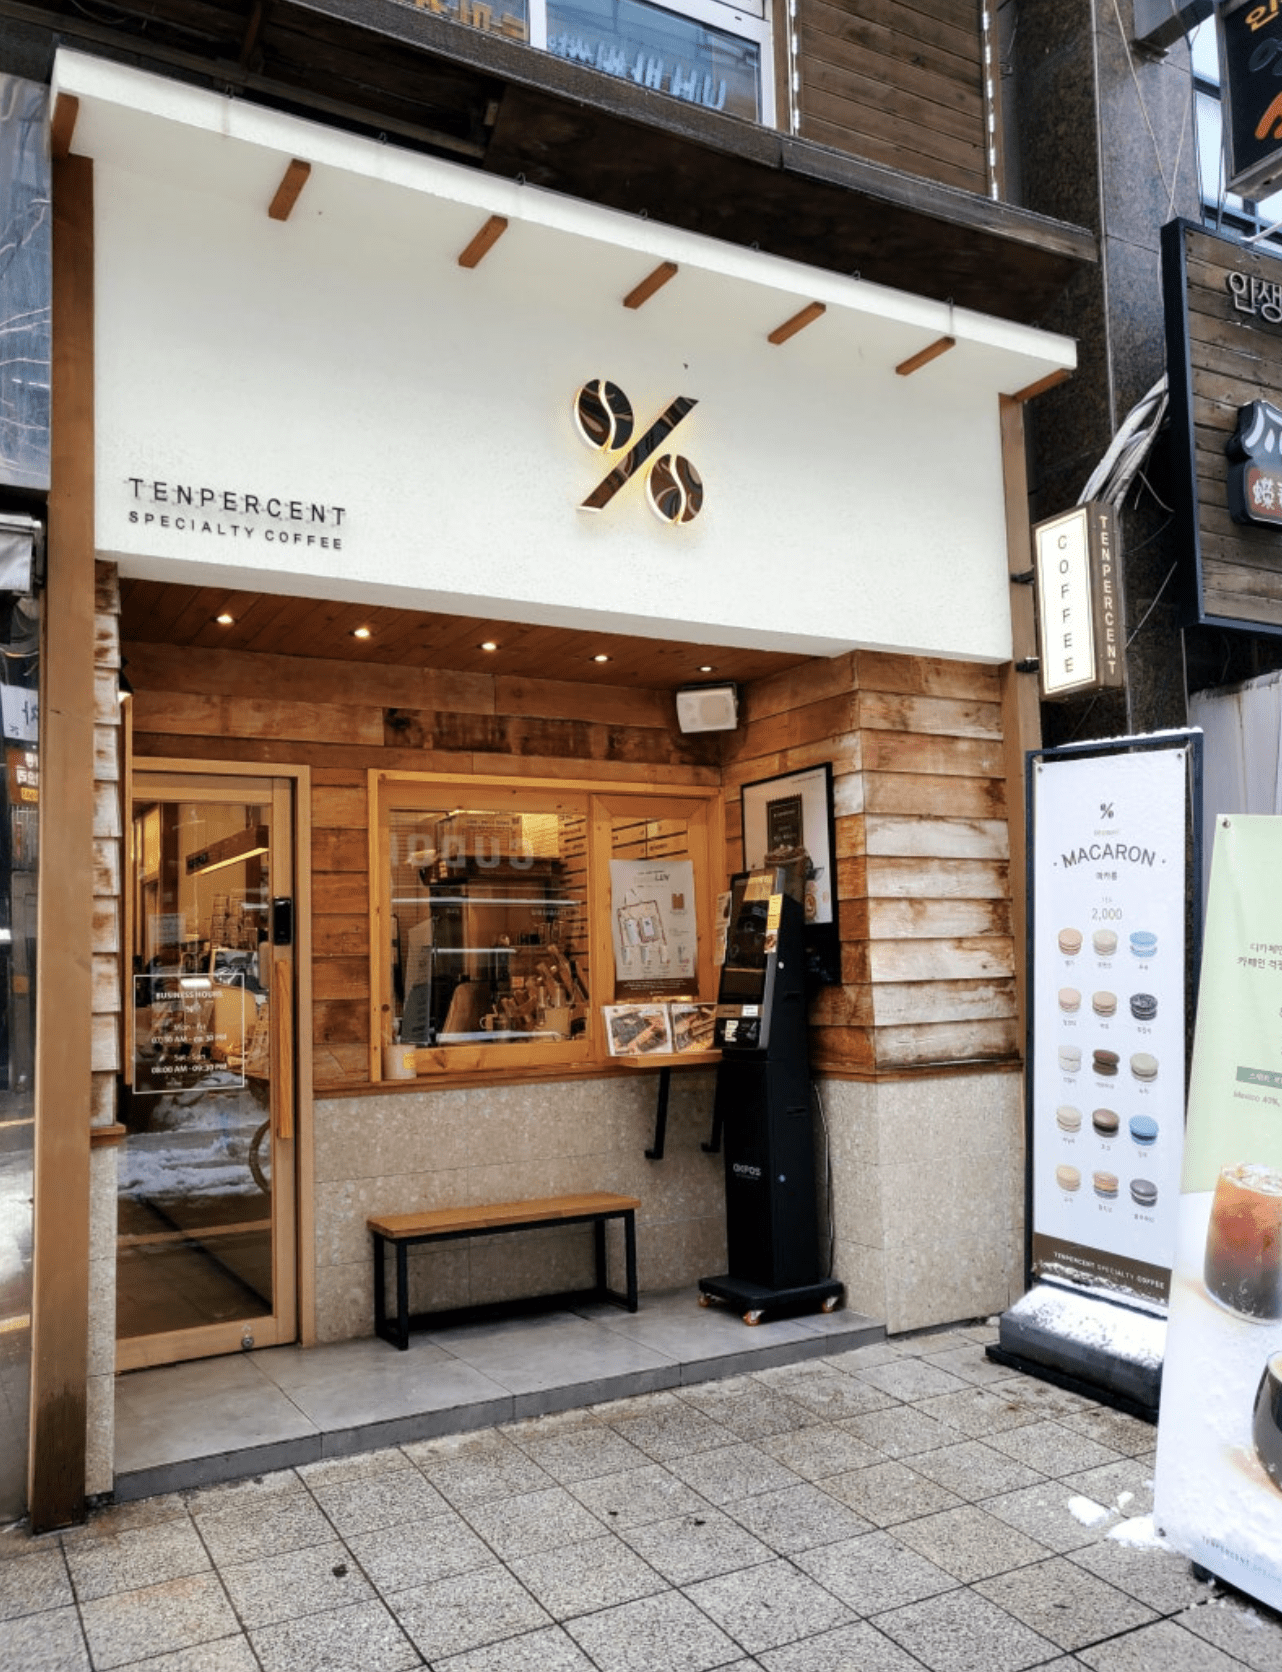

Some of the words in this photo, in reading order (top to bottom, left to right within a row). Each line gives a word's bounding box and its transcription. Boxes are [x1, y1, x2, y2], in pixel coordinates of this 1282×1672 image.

[128, 477, 346, 526] TENPERCENT
[128, 510, 255, 539] SPECIALTY
[264, 529, 343, 550] COFFEE
[1057, 534, 1074, 674] COFFEE
[1099, 515, 1117, 675] TENPERCENT
[1061, 843, 1156, 868] MACARON
[1091, 907, 1123, 922] 2,000
[1136, 1274, 1165, 1290] COFFEE
